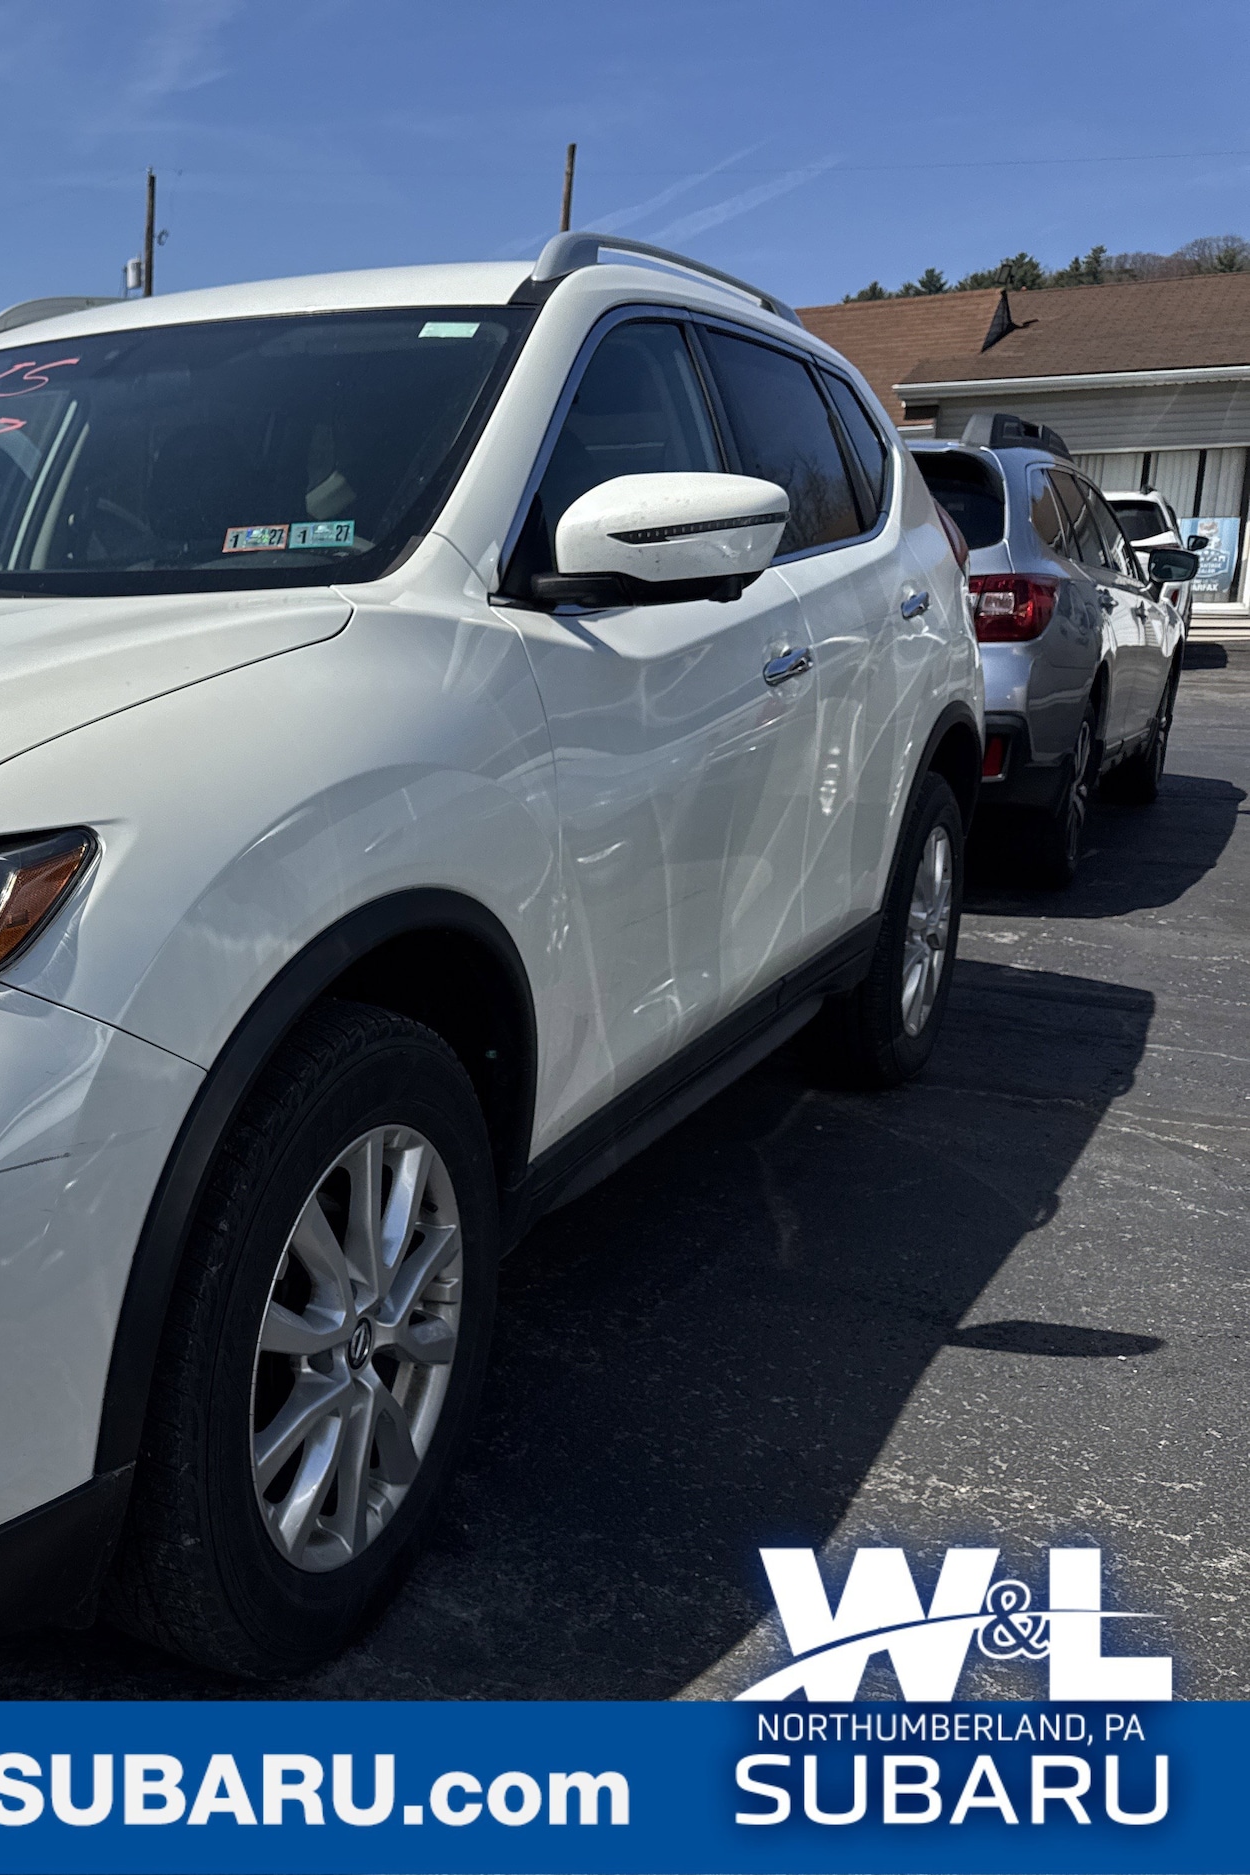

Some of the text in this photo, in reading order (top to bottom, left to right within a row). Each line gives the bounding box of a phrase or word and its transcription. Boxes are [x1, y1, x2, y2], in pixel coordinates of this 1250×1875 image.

[268, 528, 284, 546] 27
[335, 524, 350, 542] 27
[1190, 583, 1219, 592] ARFAX
